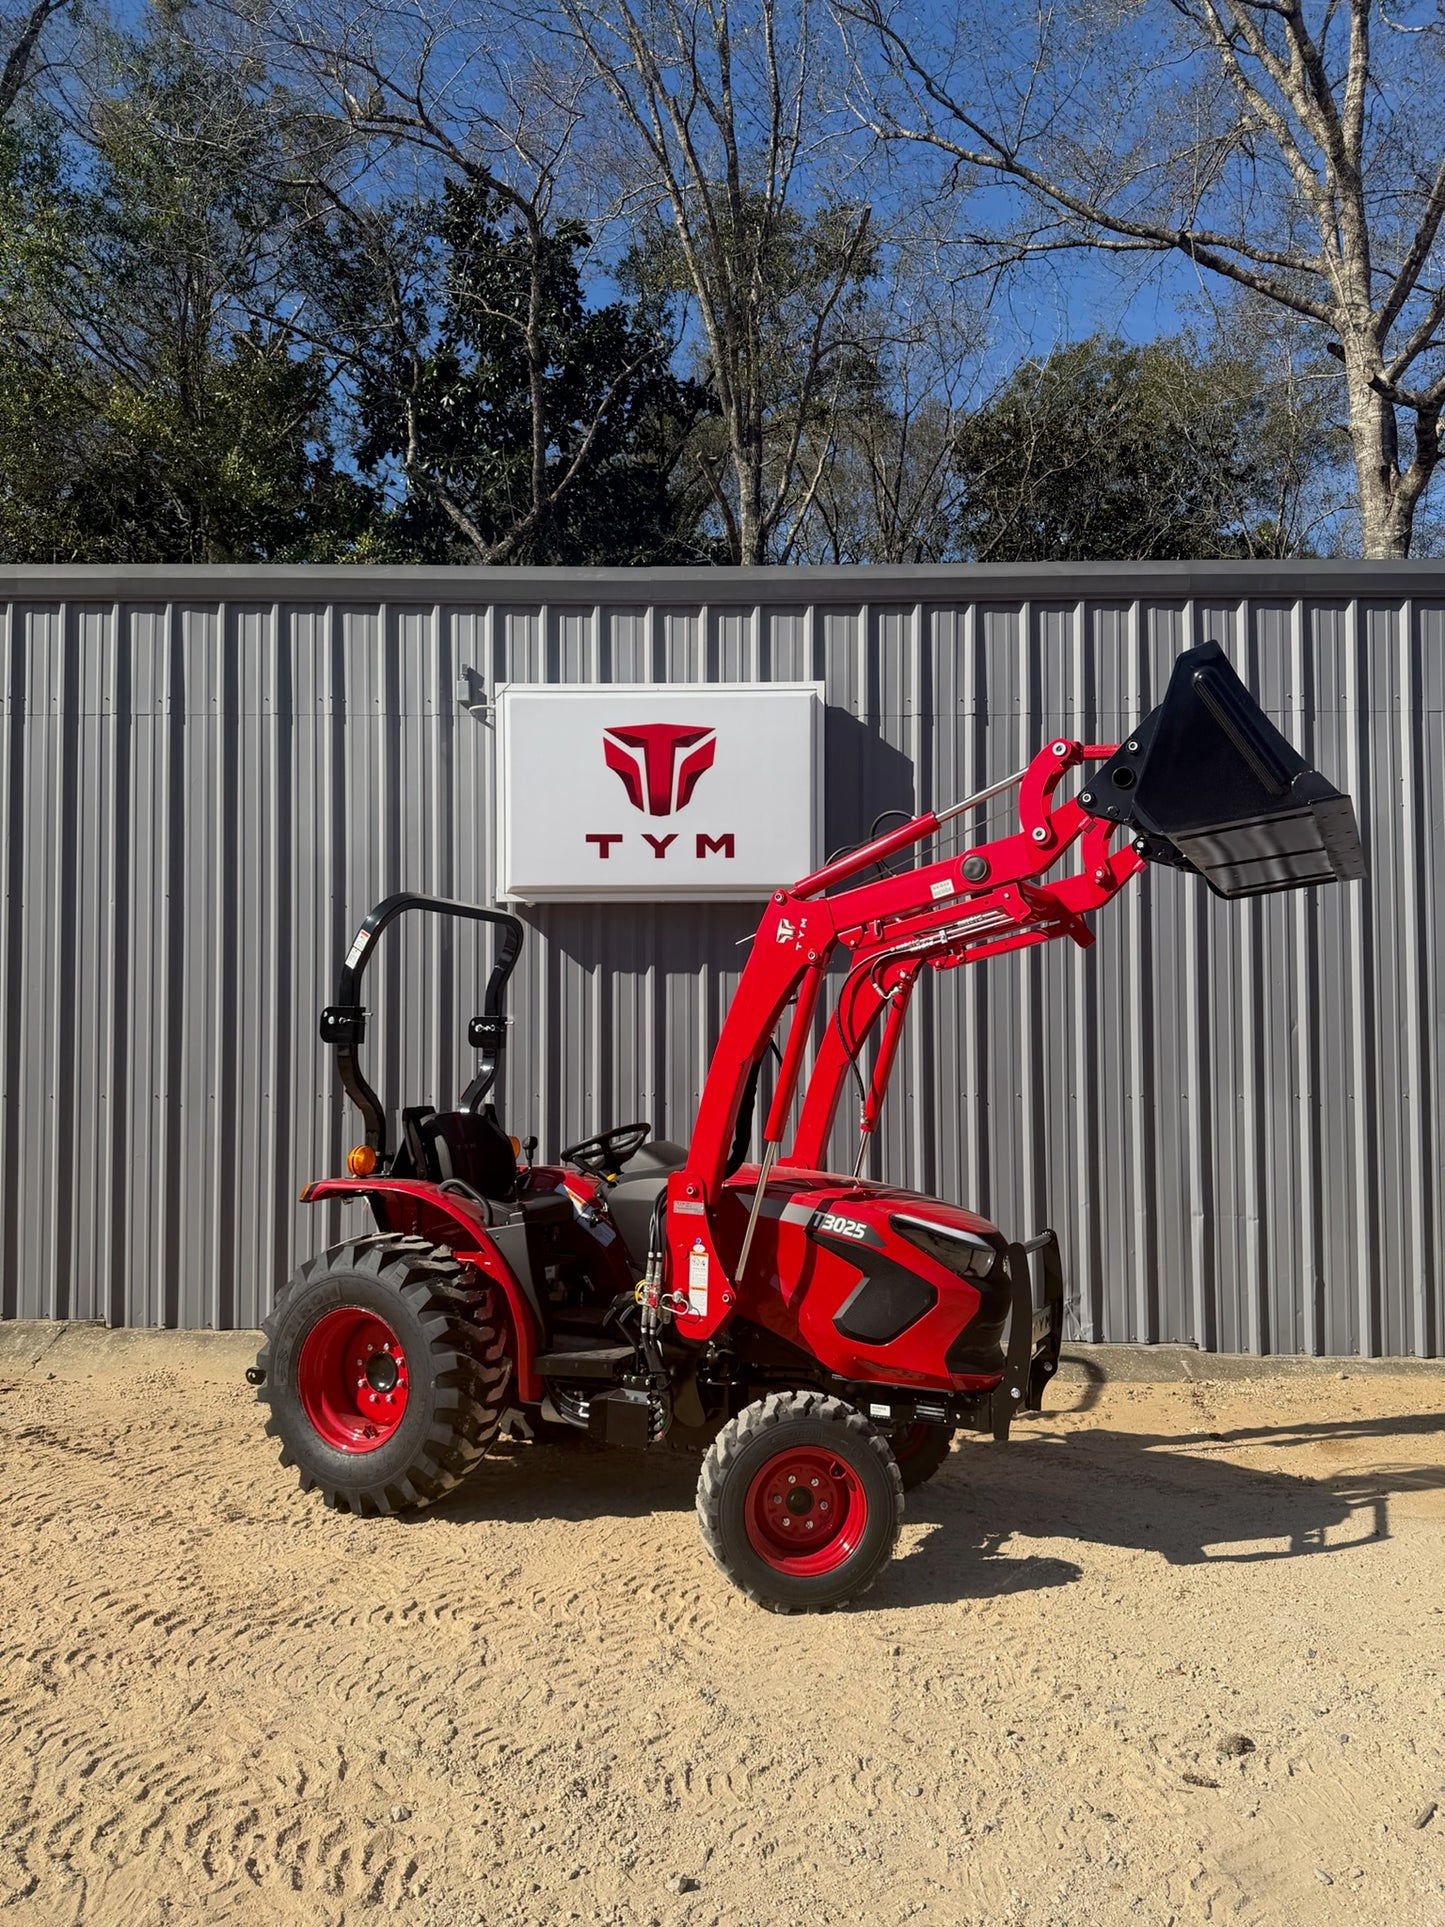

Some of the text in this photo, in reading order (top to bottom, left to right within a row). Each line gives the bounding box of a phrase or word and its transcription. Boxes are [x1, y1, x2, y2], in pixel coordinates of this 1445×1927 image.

[585, 833, 735, 859] TYM
[795, 918, 808, 951] TYM
[814, 1210, 868, 1239] T3025
